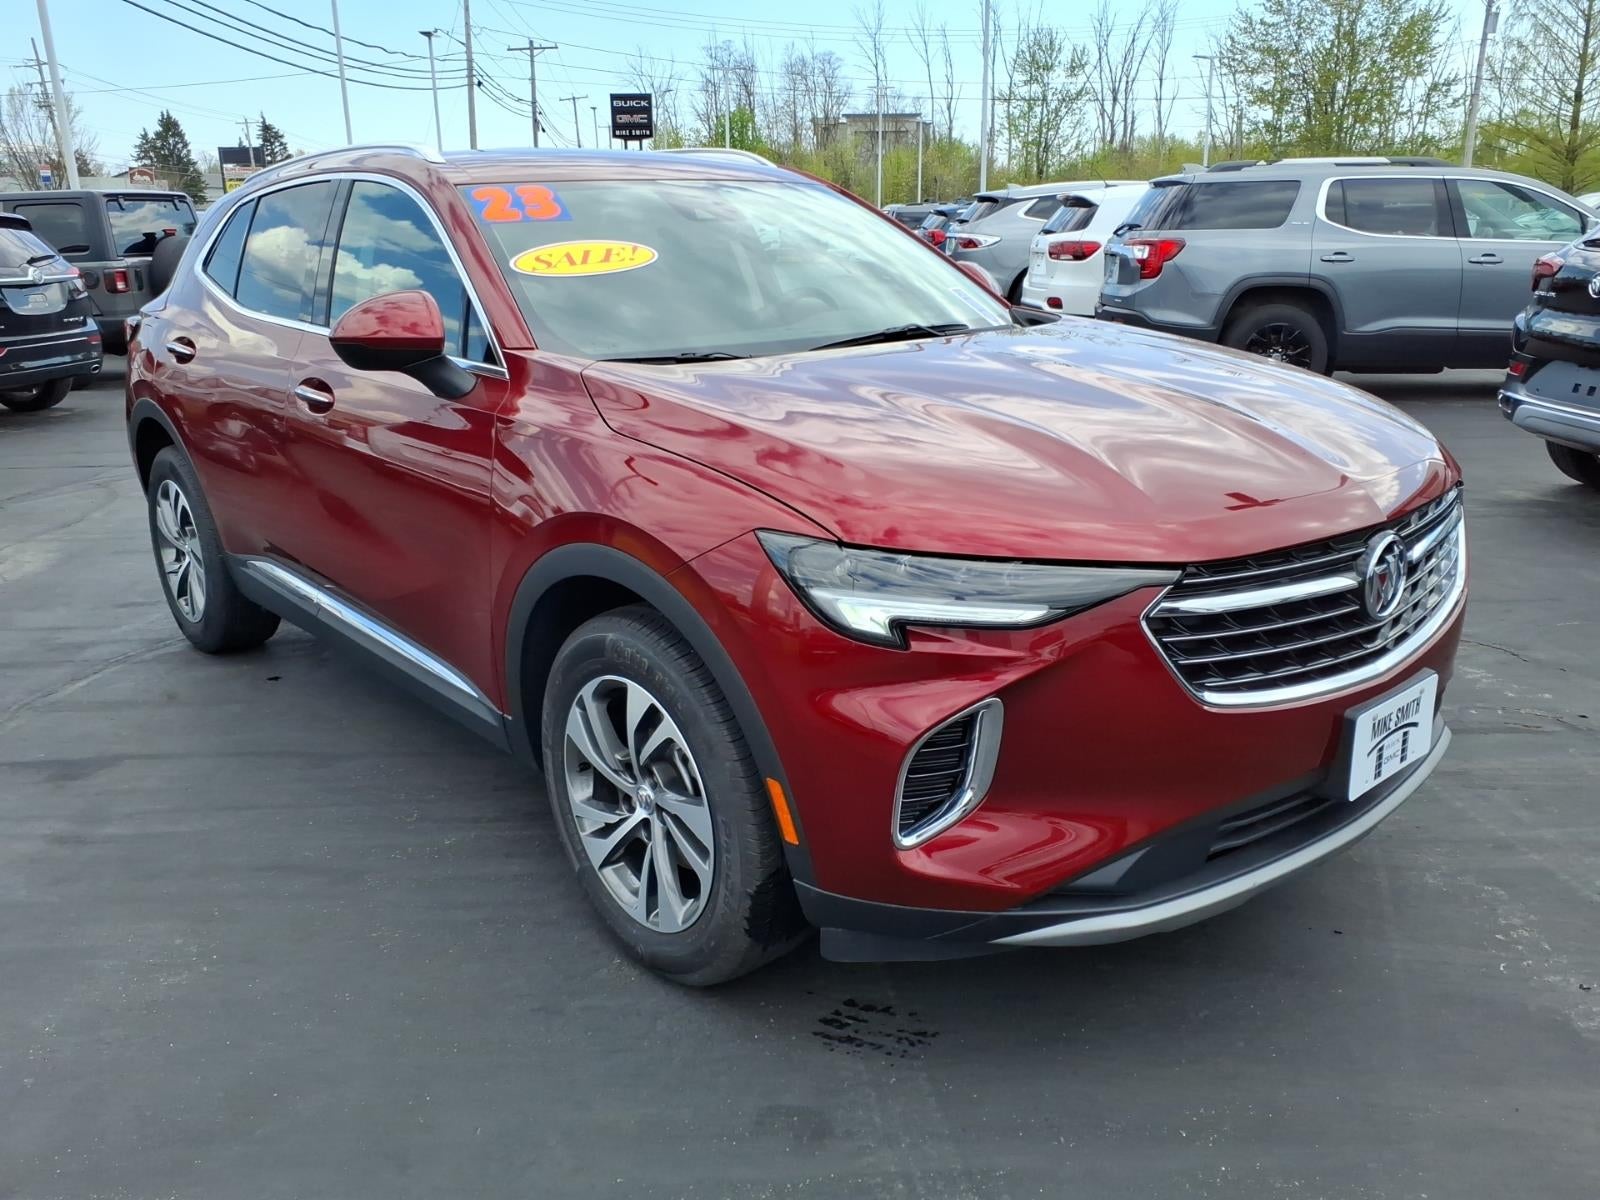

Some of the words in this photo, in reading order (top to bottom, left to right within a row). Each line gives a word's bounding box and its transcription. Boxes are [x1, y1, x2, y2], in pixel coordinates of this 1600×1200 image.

[616, 114, 648, 123] GMC
[471, 184, 562, 223] 23
[531, 245, 639, 273] SALE!
[1371, 711, 1394, 741] MIKE
[1394, 695, 1422, 727] SMITH
